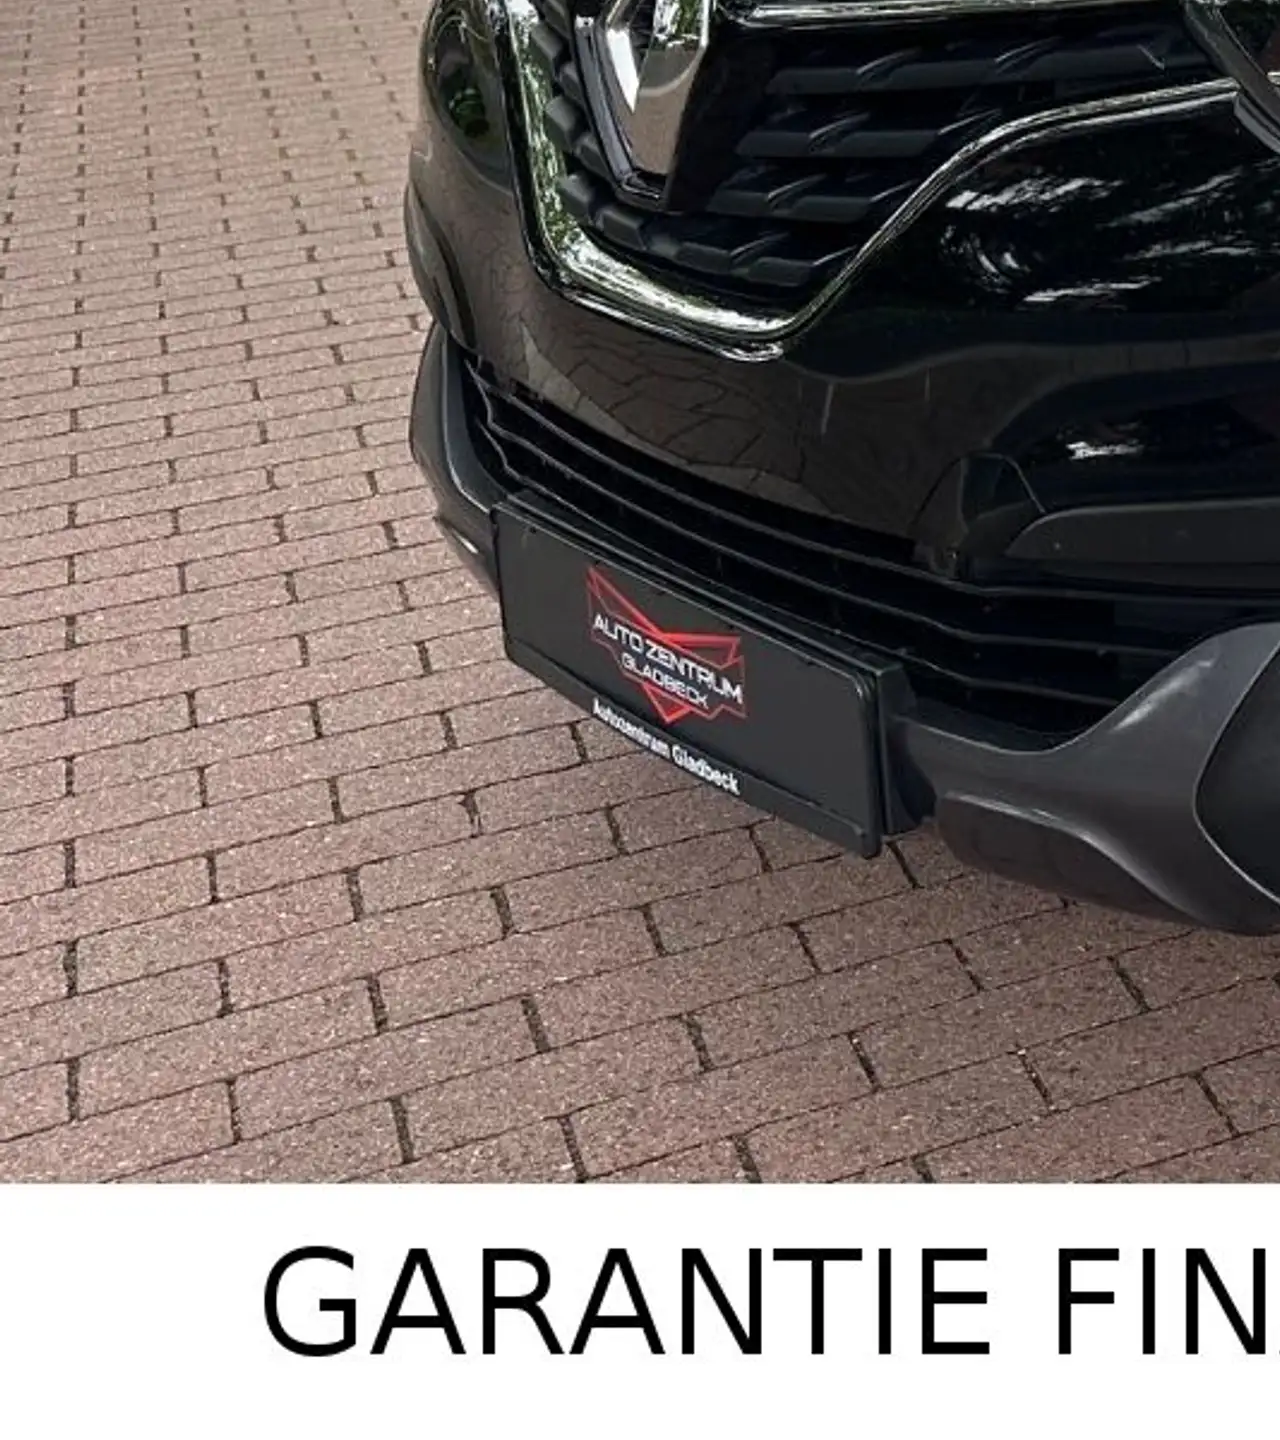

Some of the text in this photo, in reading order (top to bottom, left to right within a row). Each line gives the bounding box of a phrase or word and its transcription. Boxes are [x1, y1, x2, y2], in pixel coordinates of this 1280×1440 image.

[592, 612, 744, 706] AUTO ZENTRUM
[621, 652, 709, 710] GLADBECK
[592, 696, 741, 797] Autozentrum Gladbeck
